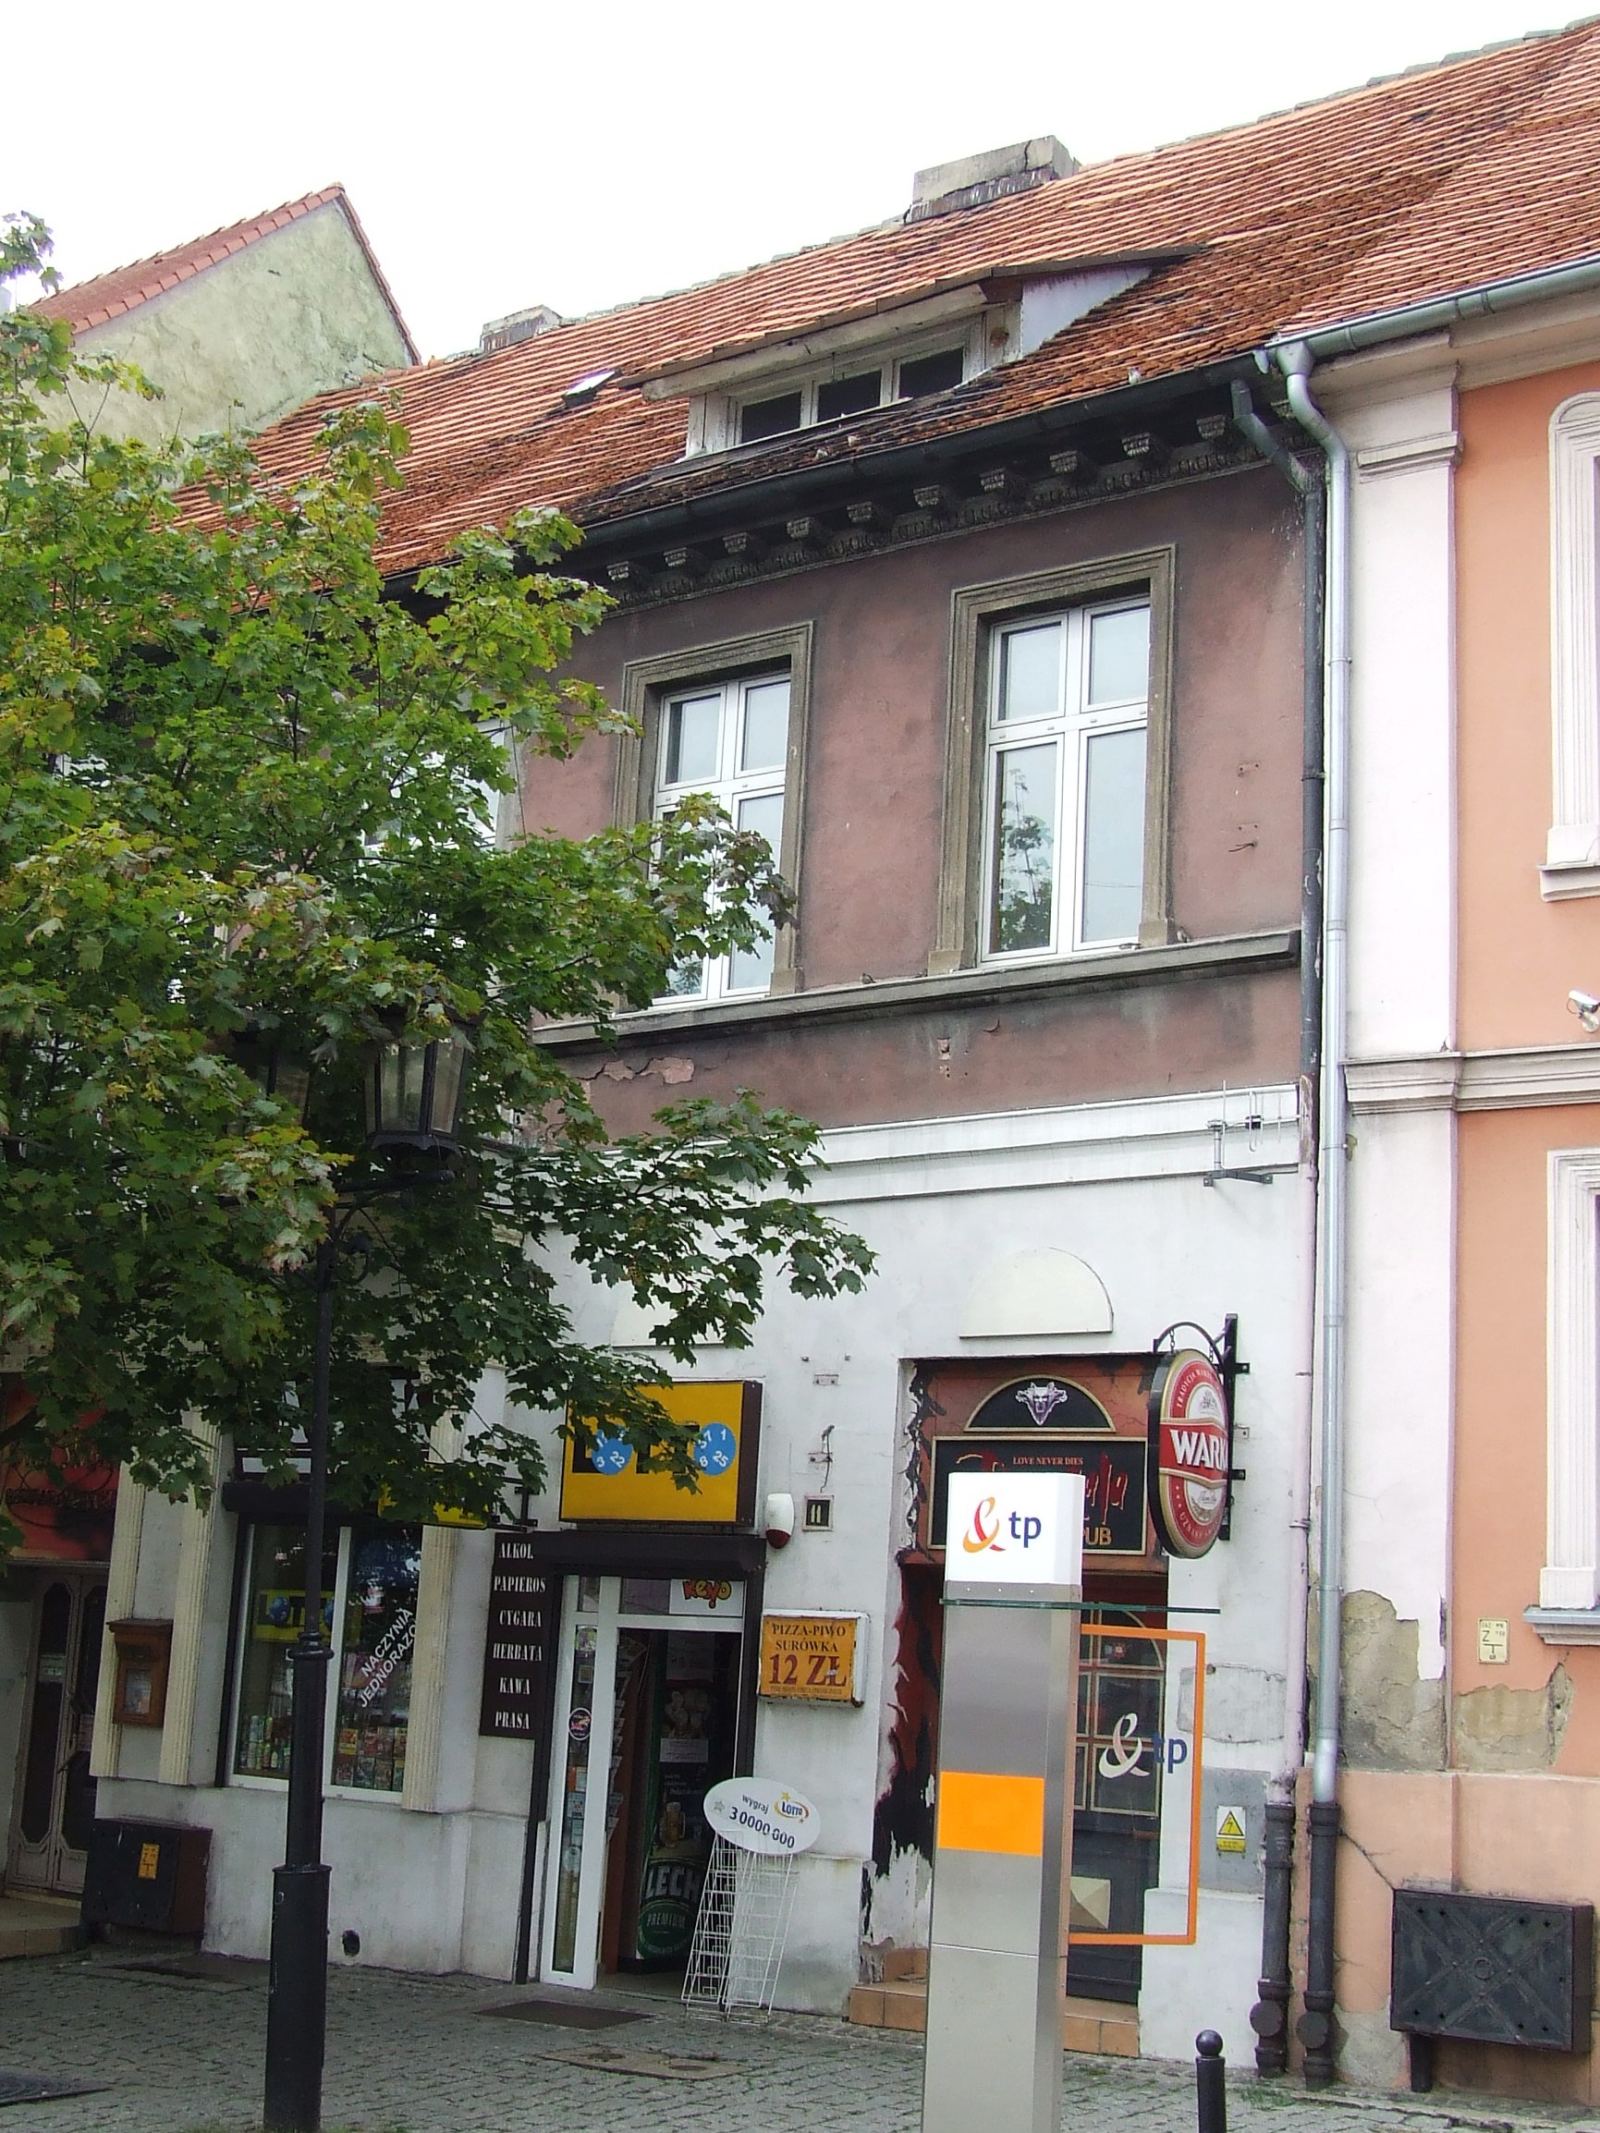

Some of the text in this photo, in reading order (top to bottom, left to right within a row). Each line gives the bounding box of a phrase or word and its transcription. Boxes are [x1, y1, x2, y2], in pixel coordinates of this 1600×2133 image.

[712, 1450, 729, 1468] 25
[1012, 1456, 1084, 1466] LOVE NEVER DIES
[1008, 1511, 1042, 1548] tp
[493, 1575, 547, 1593] PAPIEROS
[499, 1609, 542, 1628] CYGARA
[771, 1622, 847, 1638] PIZZA-PIWO
[361, 1607, 414, 1678] NACZYNIA
[492, 1643, 542, 1661] HERBATA
[775, 1637, 838, 1652] SURÓWKA
[359, 1621, 417, 1708] JEDNORAZO
[768, 1653, 798, 1685] 12
[499, 1676, 530, 1695] KAWA
[495, 1711, 530, 1730] PRASA
[1151, 1731, 1188, 1774] tp
[645, 1864, 700, 1903] LECH
